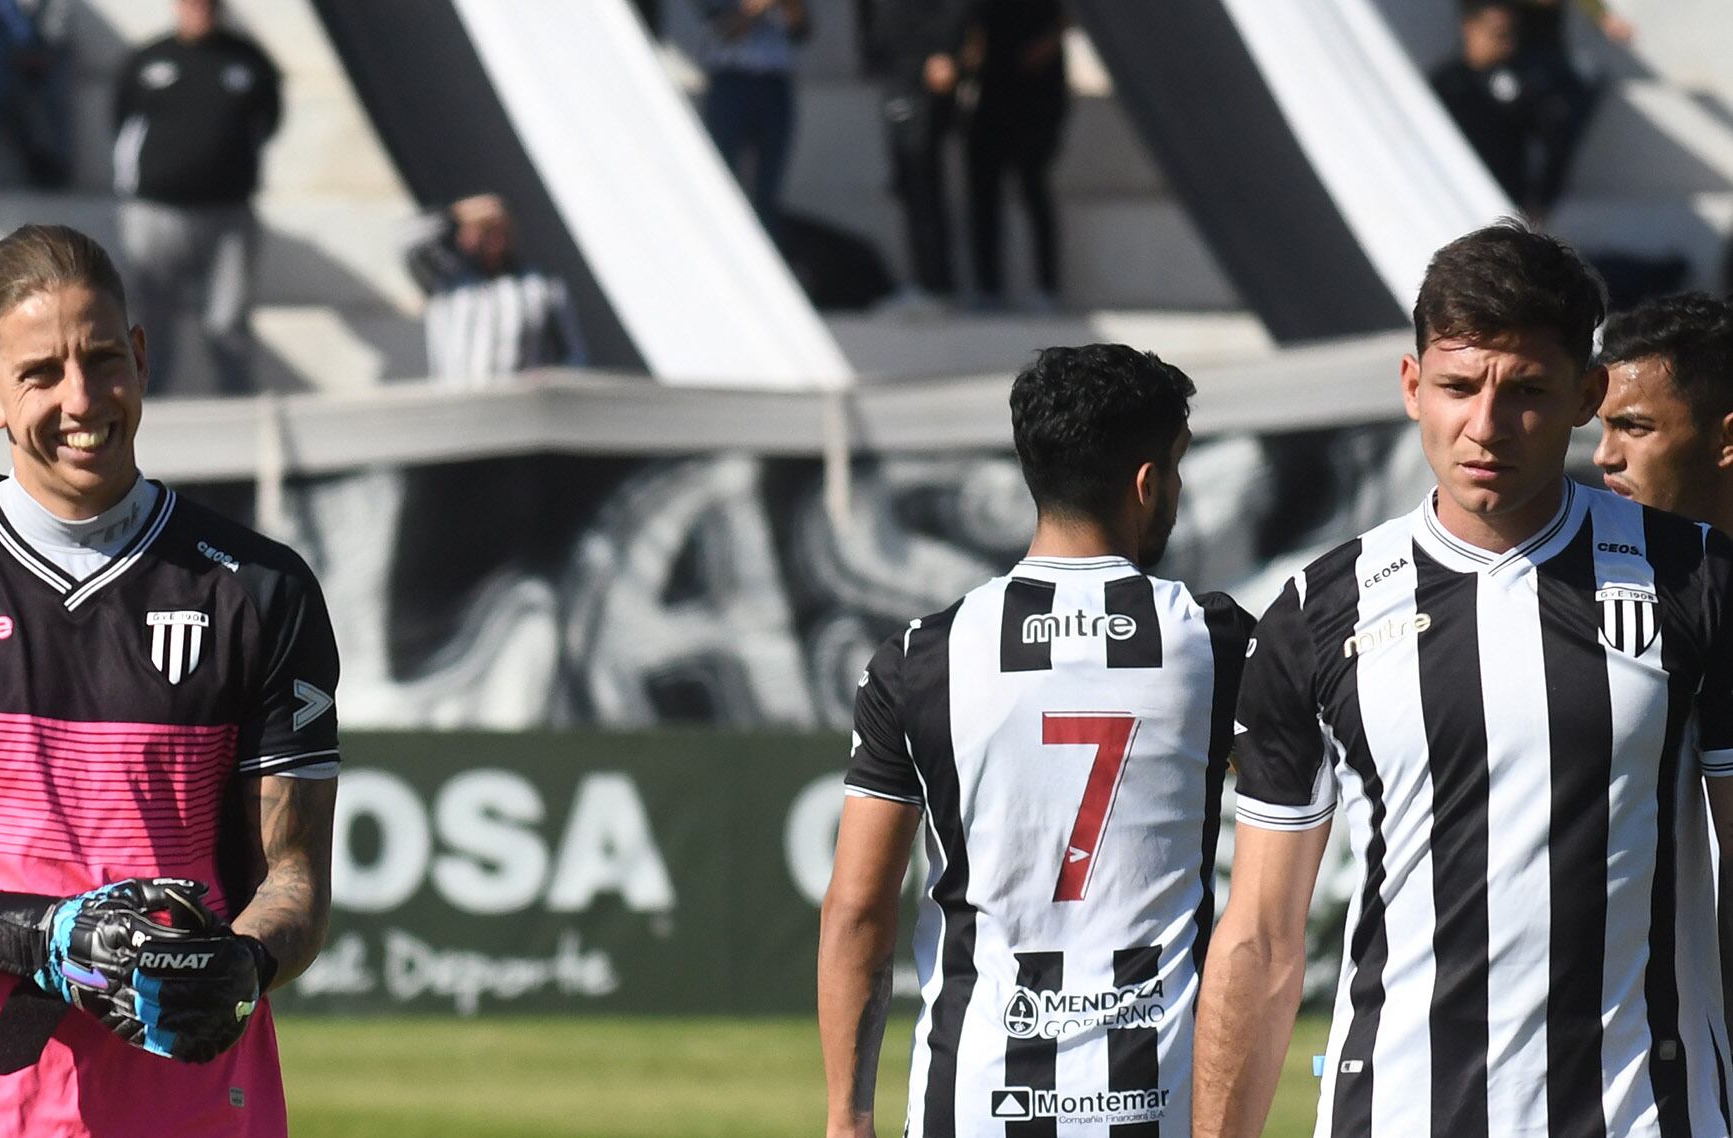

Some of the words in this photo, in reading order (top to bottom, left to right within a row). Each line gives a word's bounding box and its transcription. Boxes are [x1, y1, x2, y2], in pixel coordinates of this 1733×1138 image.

[197, 541, 239, 574] CEOSA
[1597, 542, 1644, 557] CEOS
[1364, 557, 1409, 589] CEOSA
[1022, 608, 1137, 644] mitre
[1343, 612, 1432, 659] mitre
[1042, 710, 1141, 903] 7
[329, 767, 675, 914] OSA
[139, 951, 215, 970] RINAT
[1038, 1088, 1170, 1114] Montemar
